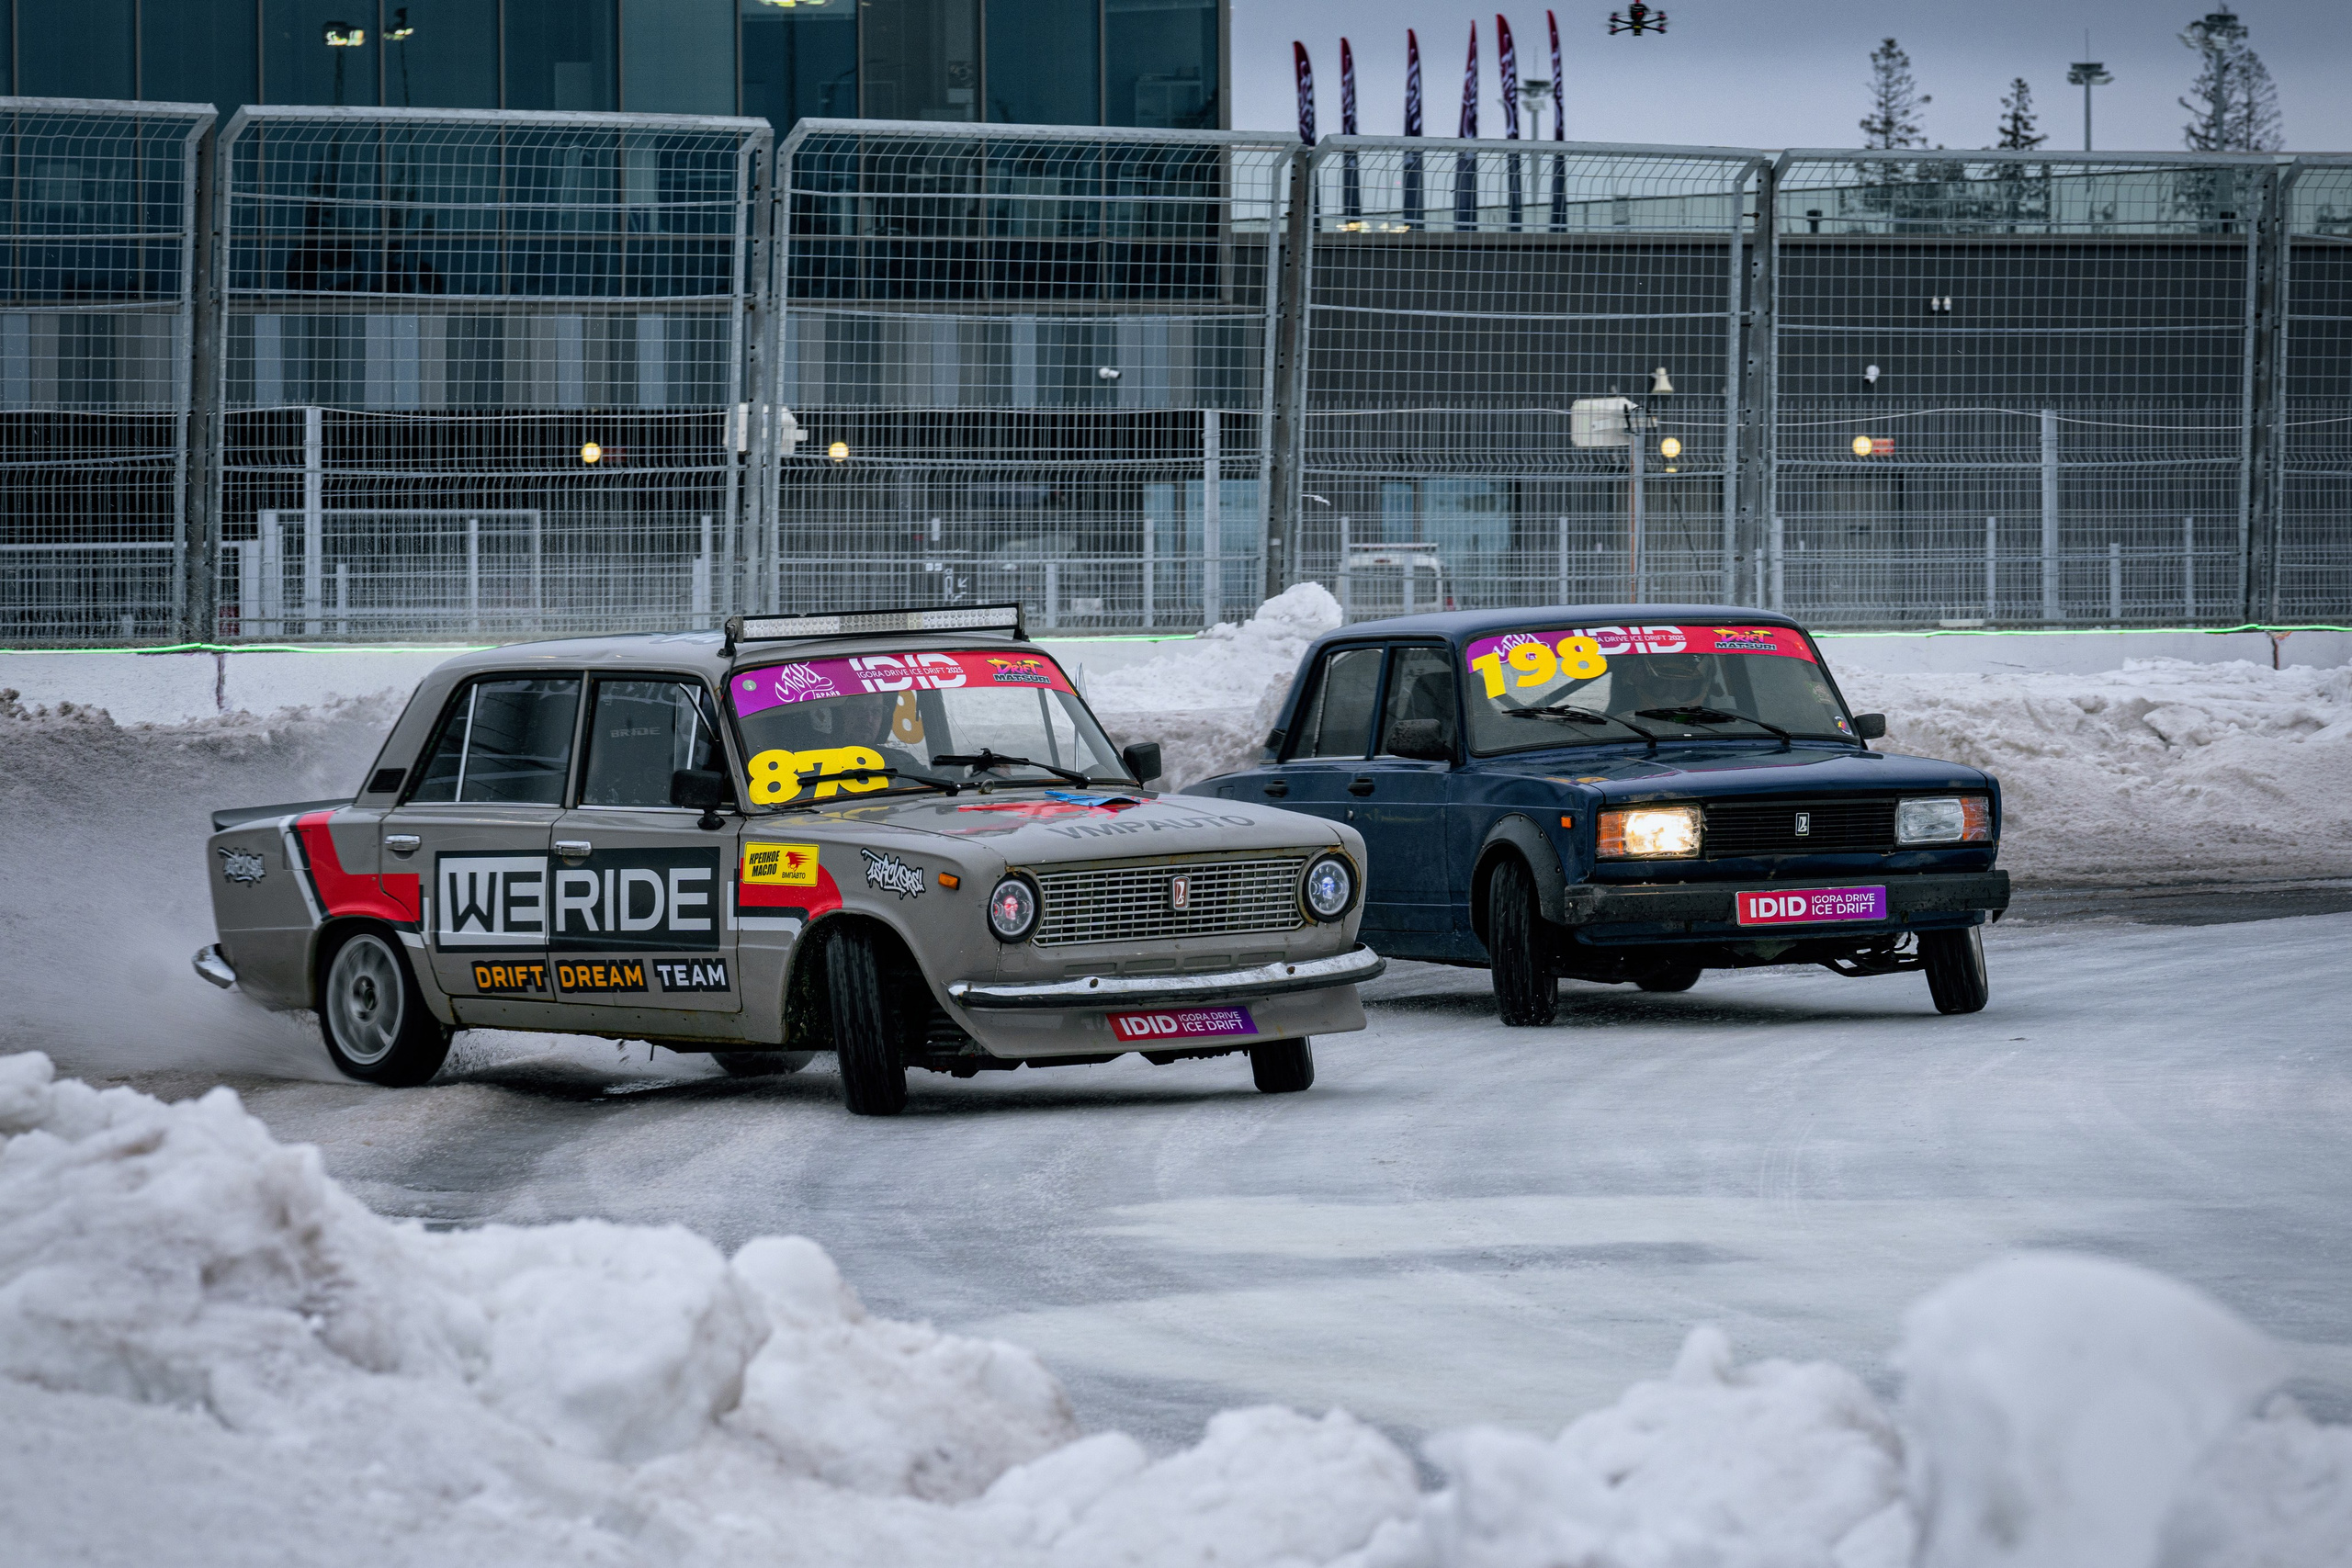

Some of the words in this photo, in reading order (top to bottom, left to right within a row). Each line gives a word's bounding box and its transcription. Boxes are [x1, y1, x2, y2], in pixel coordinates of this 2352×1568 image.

[1604, 635, 1628, 643] DRIVE
[1645, 634, 1667, 642] DRIFT
[1714, 641, 1778, 651] MATSURI
[856, 670, 885, 679] IGORA
[885, 668, 909, 677] DRIVE
[1472, 636, 1607, 699] 198
[993, 673, 1051, 684] MATSURI
[816, 690, 841, 699] ДРАЙВ
[748, 746, 888, 805] 878
[1046, 815, 1256, 840] VMPAUTO
[749, 851, 780, 864] КРЕПКОЕ
[752, 863, 777, 877] МАСЛО
[1812, 895, 1843, 904] IGORA
[1846, 893, 1875, 902] DRIVE
[1749, 897, 1806, 918] IDID
[1812, 904, 1833, 915] ICE
[1837, 902, 1875, 914] DRIFT
[474, 965, 545, 988] DRIFT
[558, 964, 645, 988] DREAM
[656, 964, 727, 987] TEAM
[1178, 1012, 1210, 1022] IGORA
[1212, 1011, 1240, 1021] DRIVE
[1119, 1015, 1178, 1036] IDID
[1182, 1021, 1204, 1032] ICE
[1206, 1020, 1243, 1031] DRIFT
